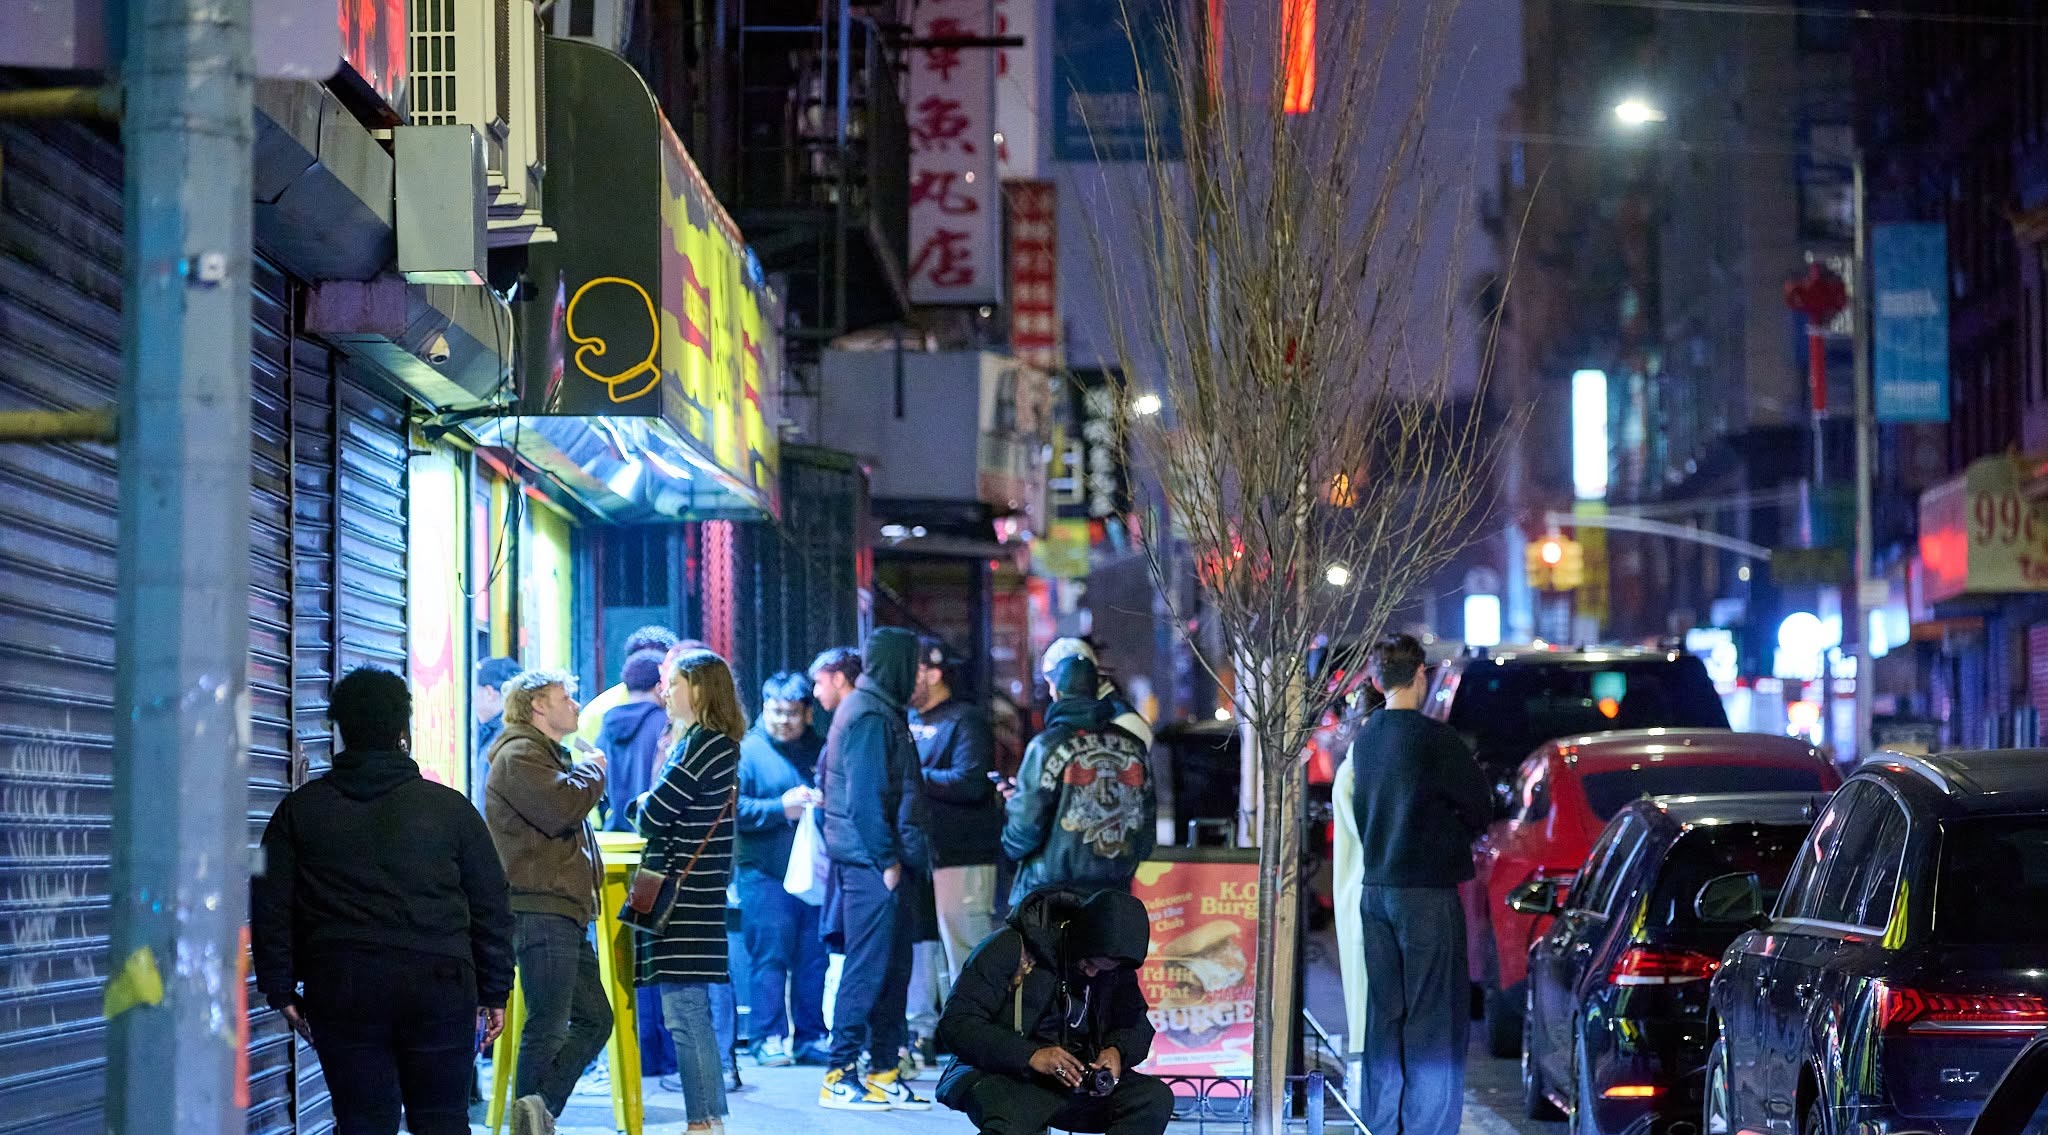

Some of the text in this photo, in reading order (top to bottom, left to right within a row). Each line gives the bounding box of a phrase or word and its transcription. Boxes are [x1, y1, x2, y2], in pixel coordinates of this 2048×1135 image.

[1200, 896, 1258, 920] Burg
[1146, 984, 1191, 999] That
[1147, 1000, 1254, 1032] BURGE
